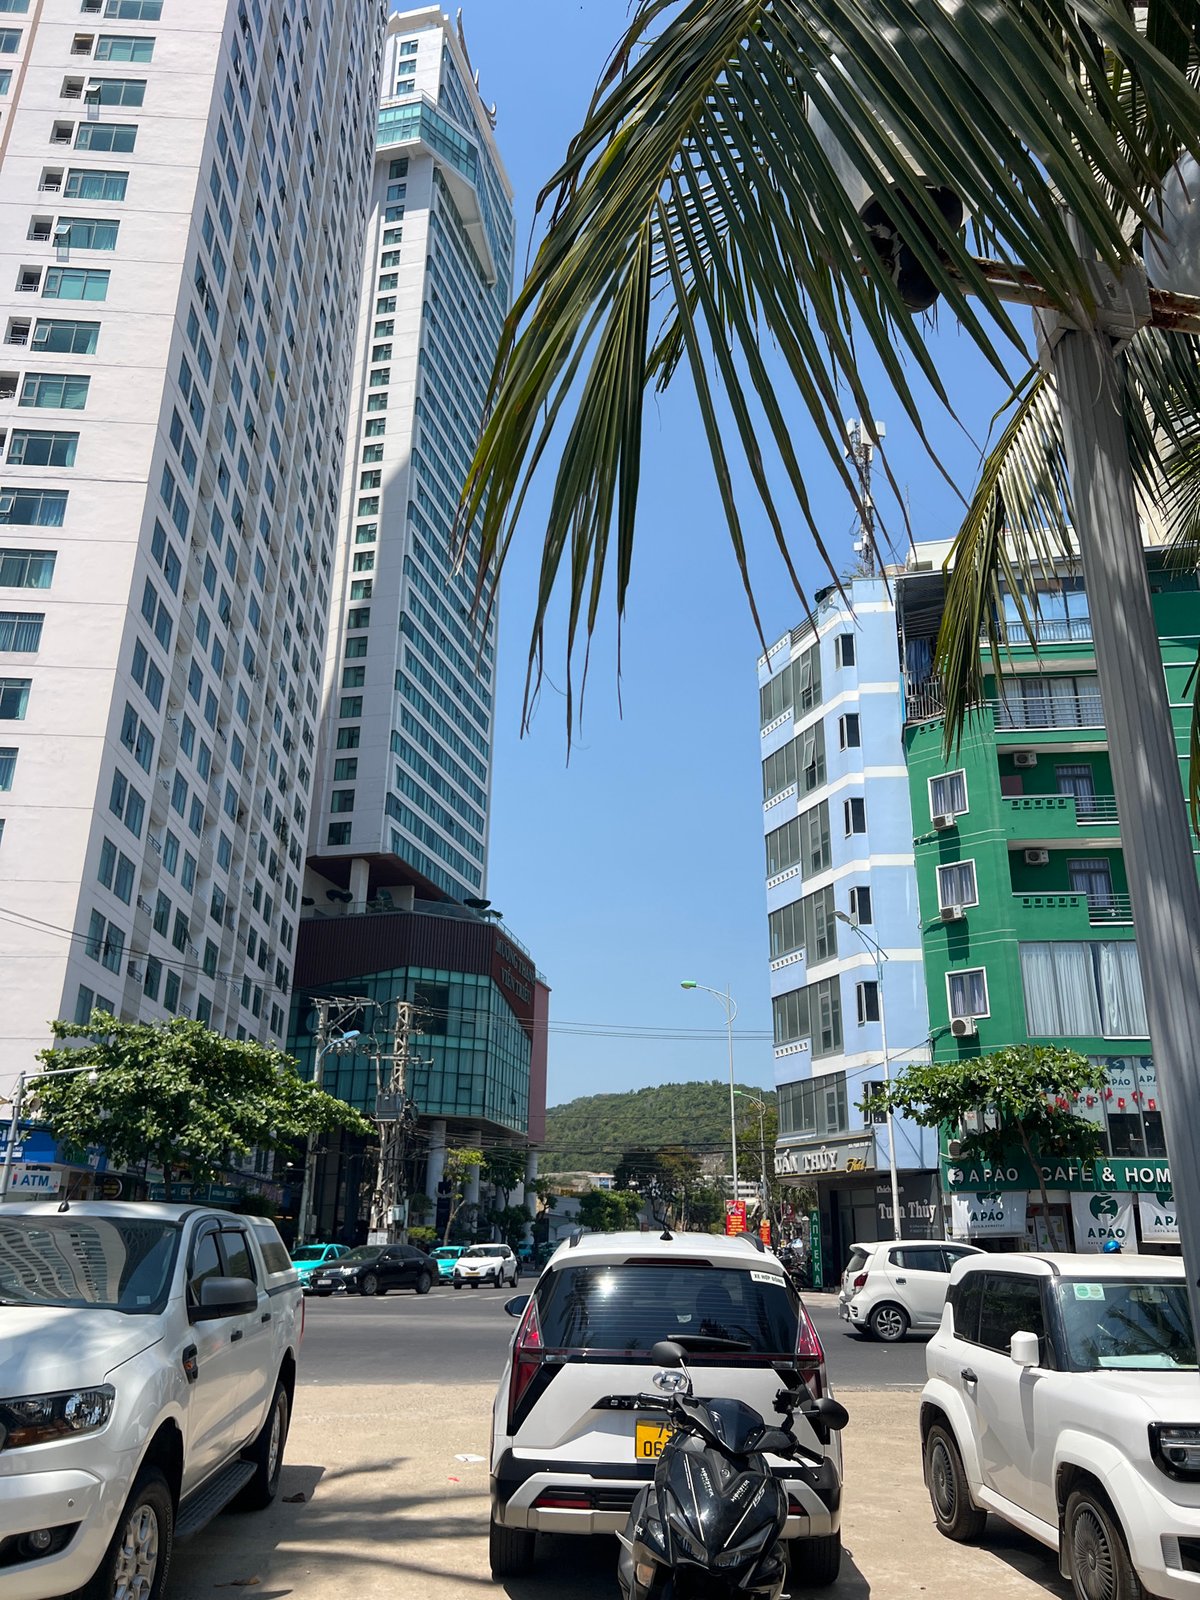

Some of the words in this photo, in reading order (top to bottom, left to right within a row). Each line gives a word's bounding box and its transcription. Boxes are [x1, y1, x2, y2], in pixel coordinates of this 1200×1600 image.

[21, 1175, 49, 1187] ATM
[1102, 1167, 1116, 1182] &
[878, 1203, 906, 1219] Tun
[812, 1212, 821, 1285] АПТЕКА
[643, 1441, 668, 1457] 06
